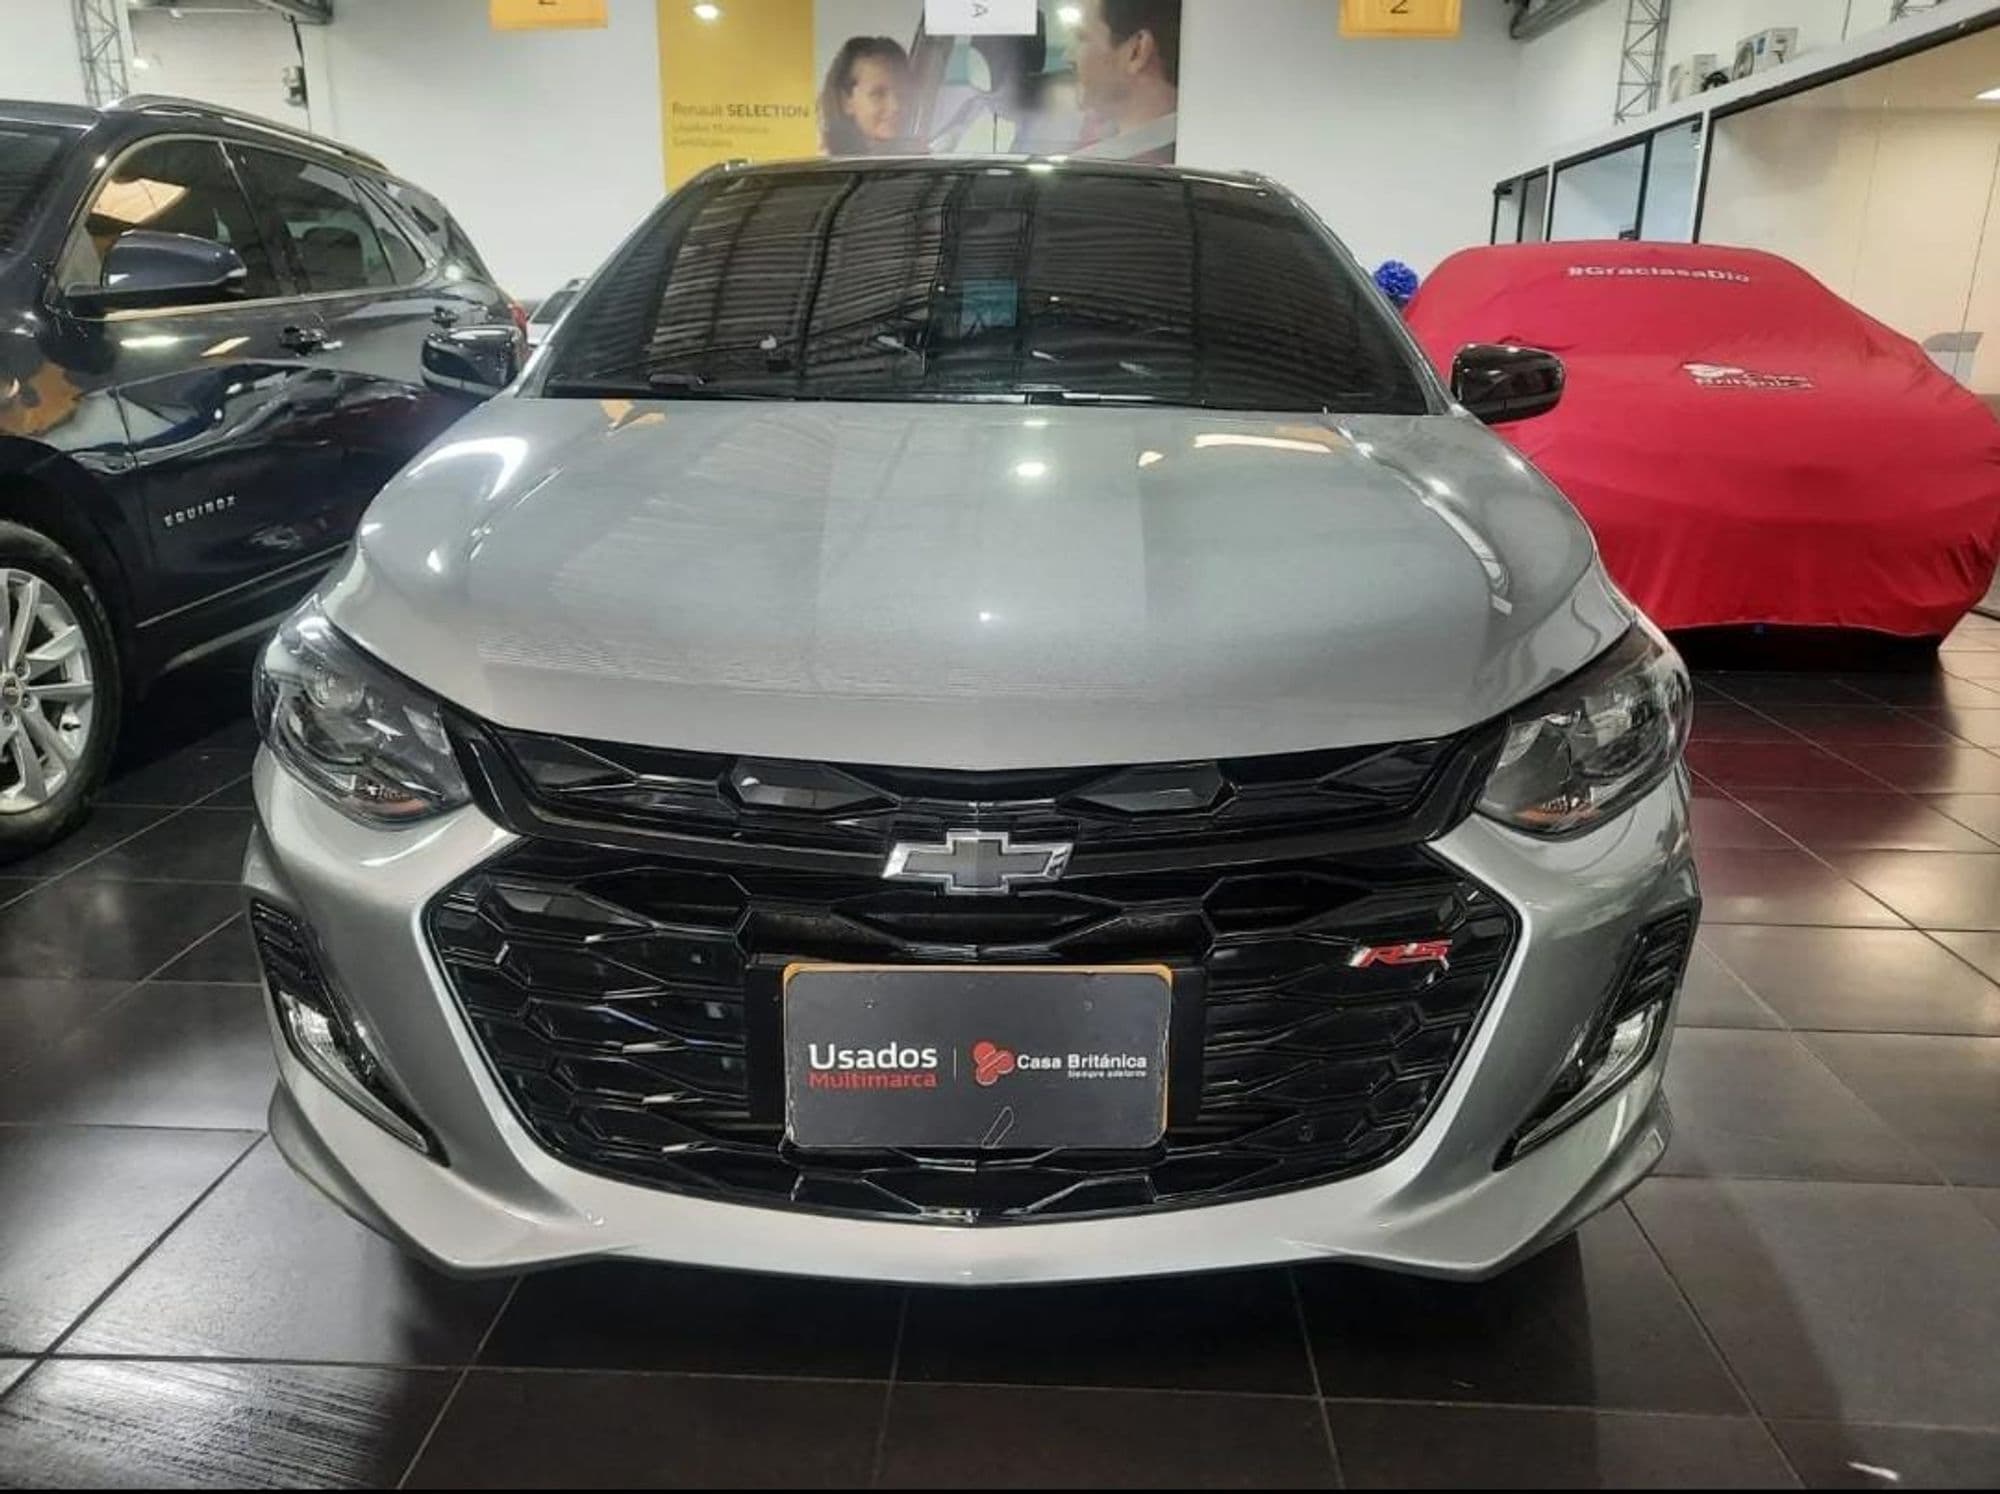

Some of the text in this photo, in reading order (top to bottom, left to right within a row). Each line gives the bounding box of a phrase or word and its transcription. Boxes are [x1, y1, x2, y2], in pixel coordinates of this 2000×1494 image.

[727, 103, 809, 118] SELECTION
[164, 495, 236, 527] EQUINOX
[1349, 939, 1453, 968] RS
[808, 1041, 938, 1070] Usados
[1016, 1053, 1148, 1070] Casa Británica
[808, 1071, 938, 1089] Multimarca
